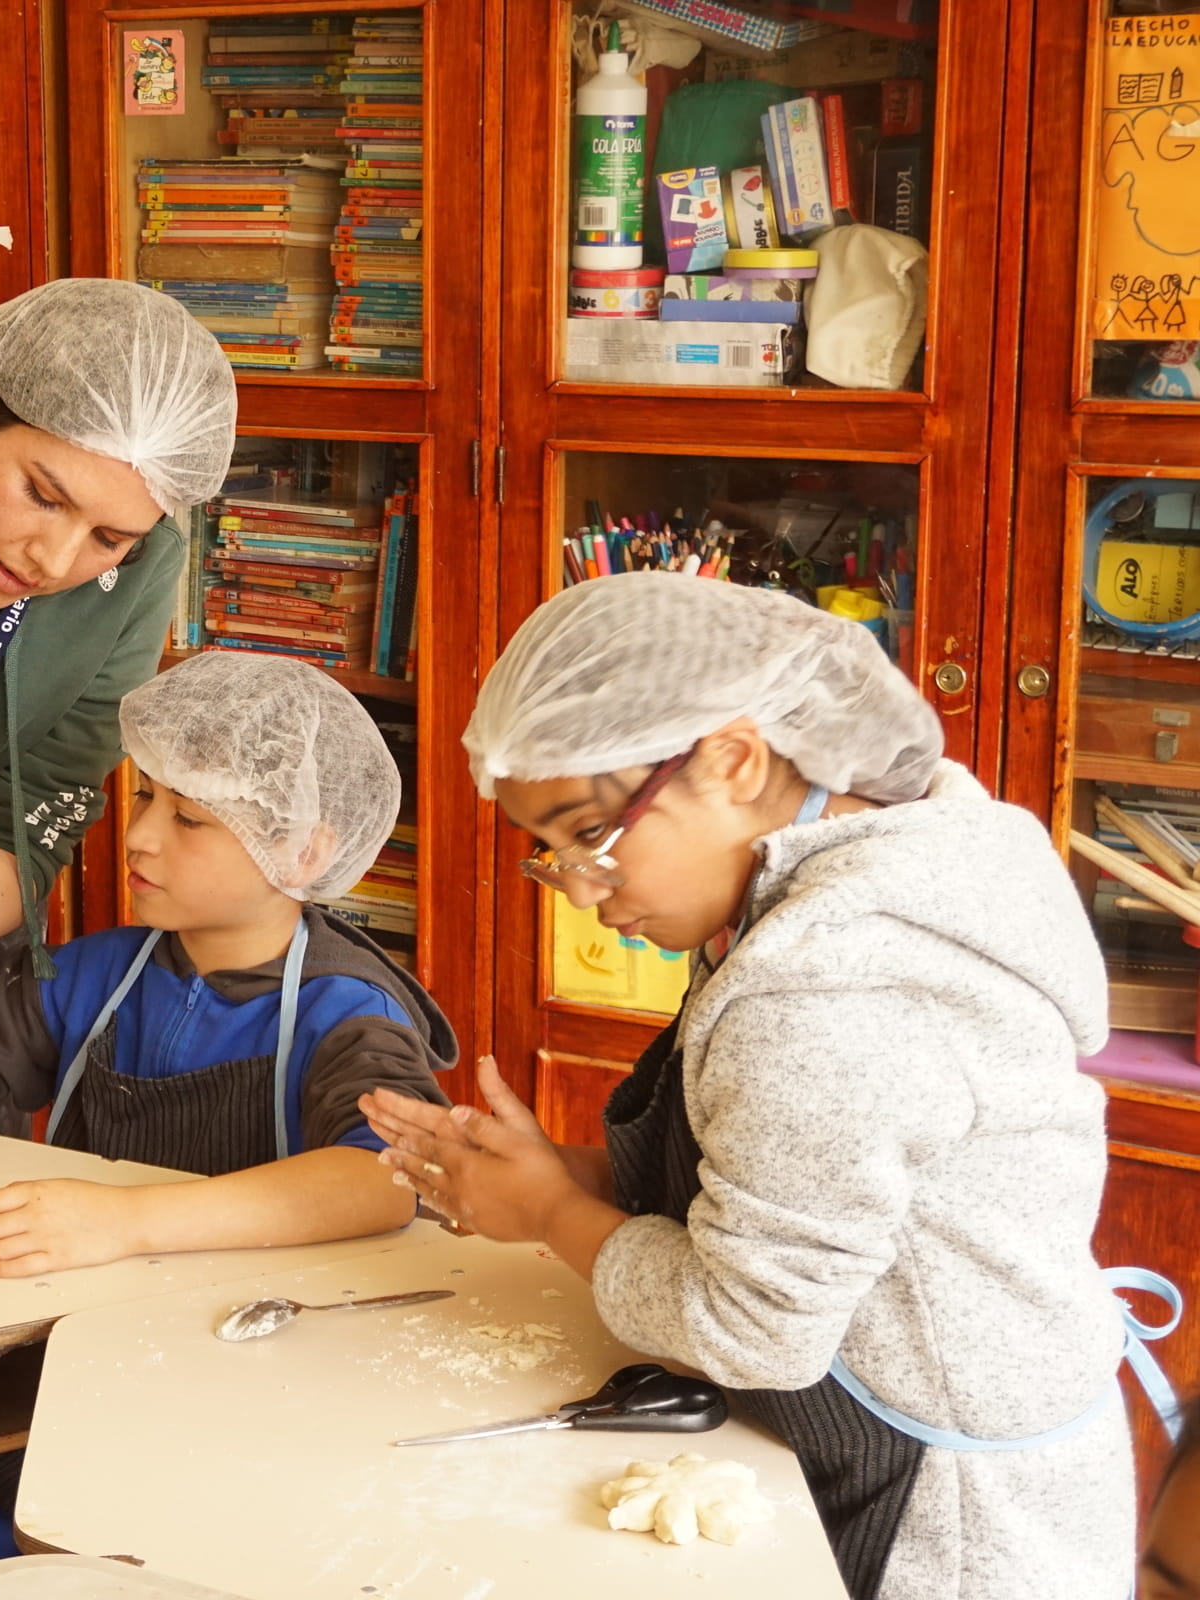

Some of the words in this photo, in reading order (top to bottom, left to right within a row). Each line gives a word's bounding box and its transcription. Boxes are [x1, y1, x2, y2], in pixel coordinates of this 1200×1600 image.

[592, 138, 619, 154] COLA
[622, 135, 642, 153] FRÍA
[603, 289, 620, 309] 6
[644, 289, 657, 309] 3
[1120, 560, 1138, 599] ALO
[0, 597, 30, 633] ario
